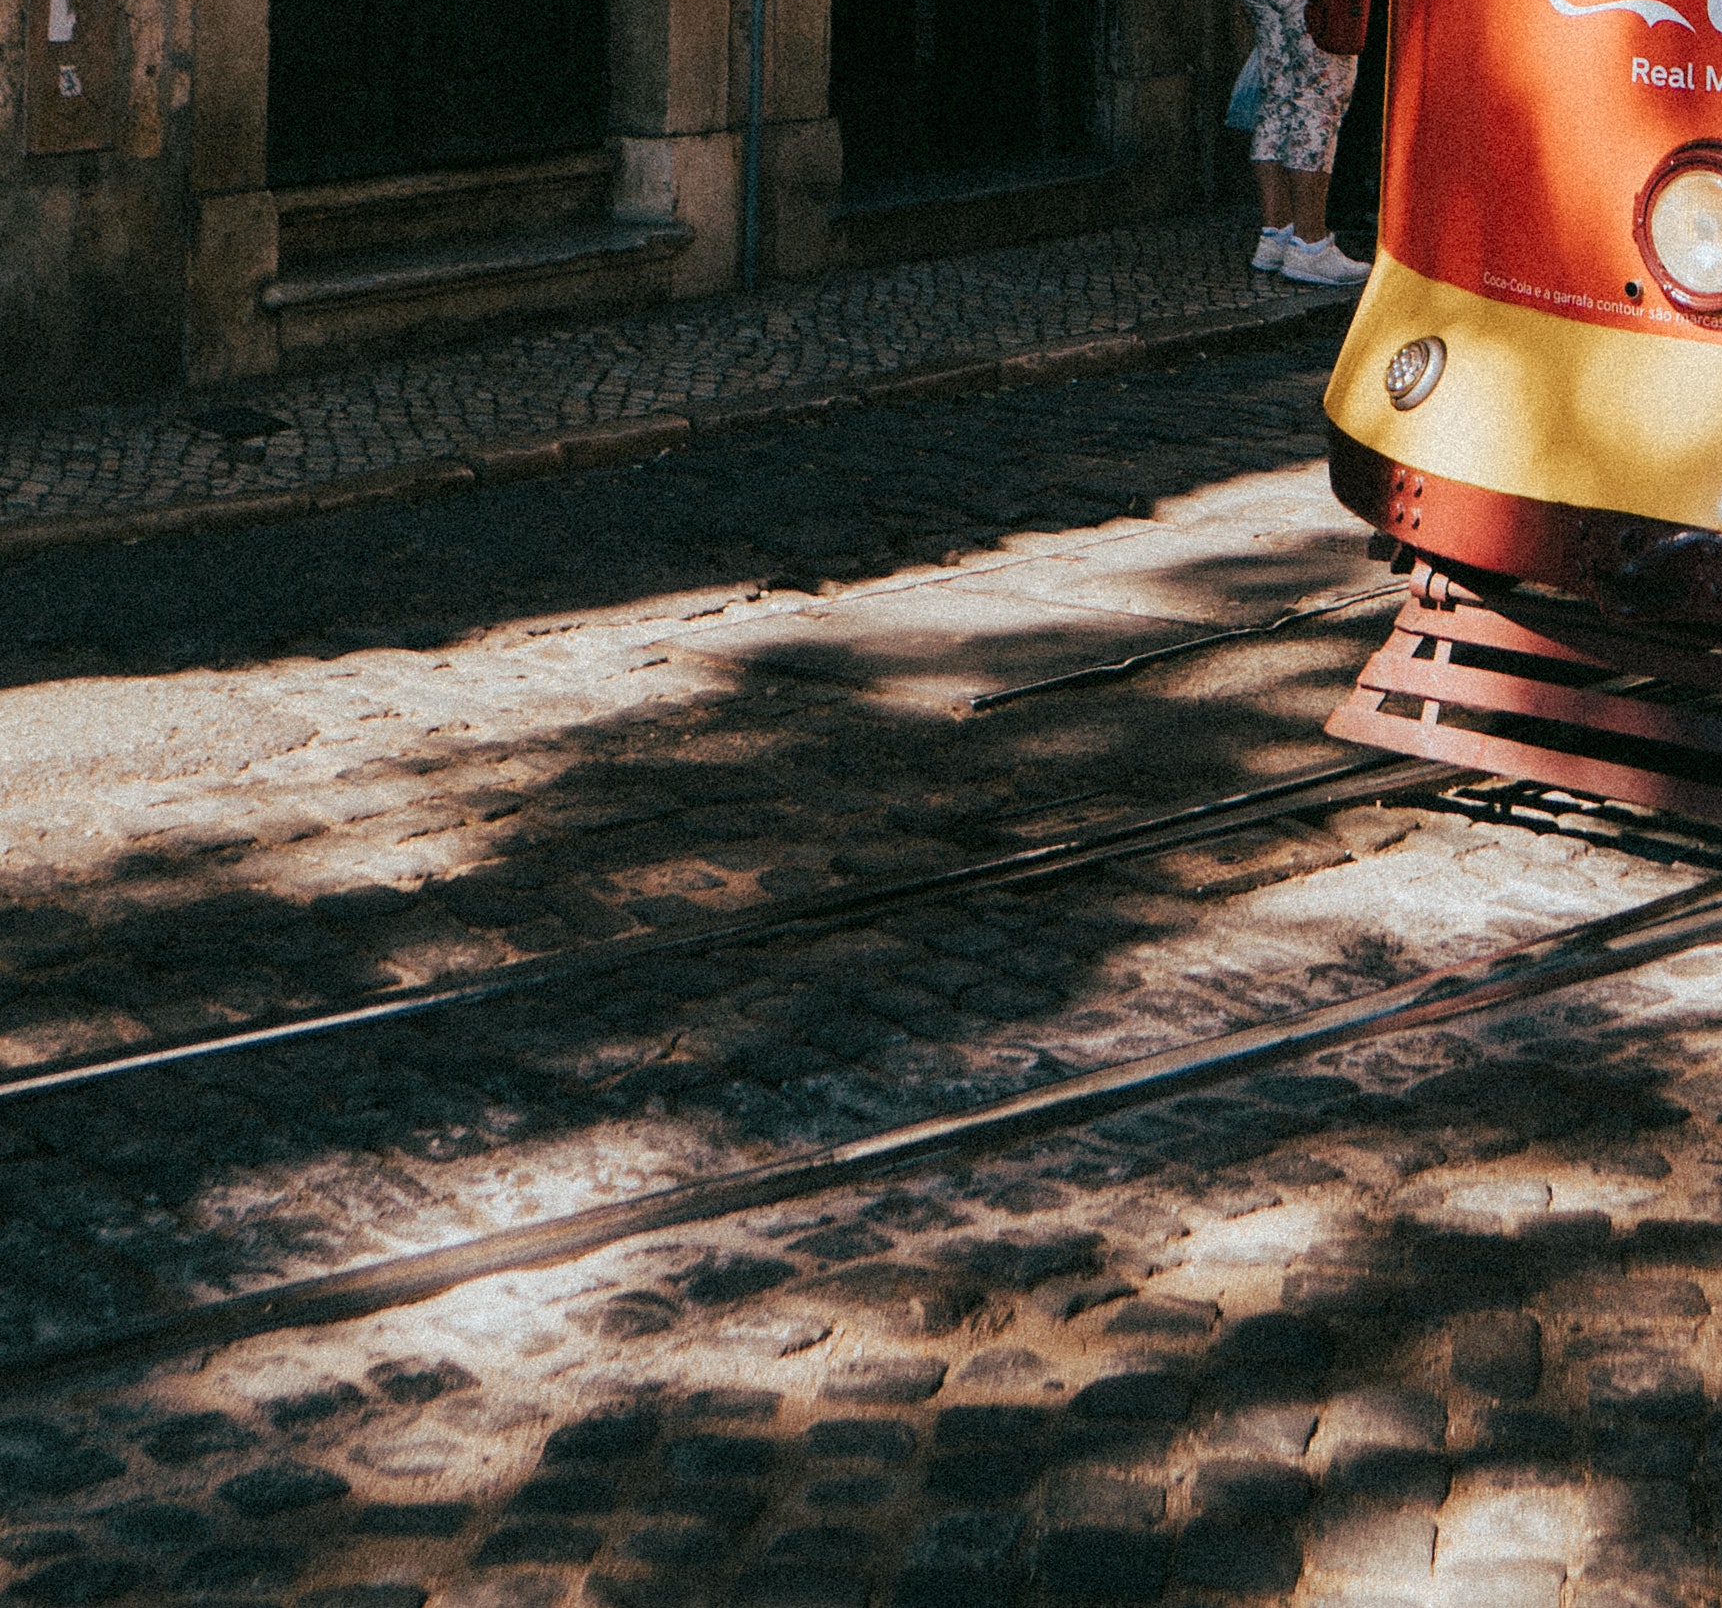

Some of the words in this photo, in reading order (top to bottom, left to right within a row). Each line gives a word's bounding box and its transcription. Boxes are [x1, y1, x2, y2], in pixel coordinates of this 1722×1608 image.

[1631, 56, 1695, 90] Real
[1482, 271, 1533, 298] Coca-Cola
[1544, 289, 1552, 301] a
[1552, 289, 1594, 309] garrafa
[1596, 298, 1645, 319] contour
[1648, 305, 1673, 323] são
